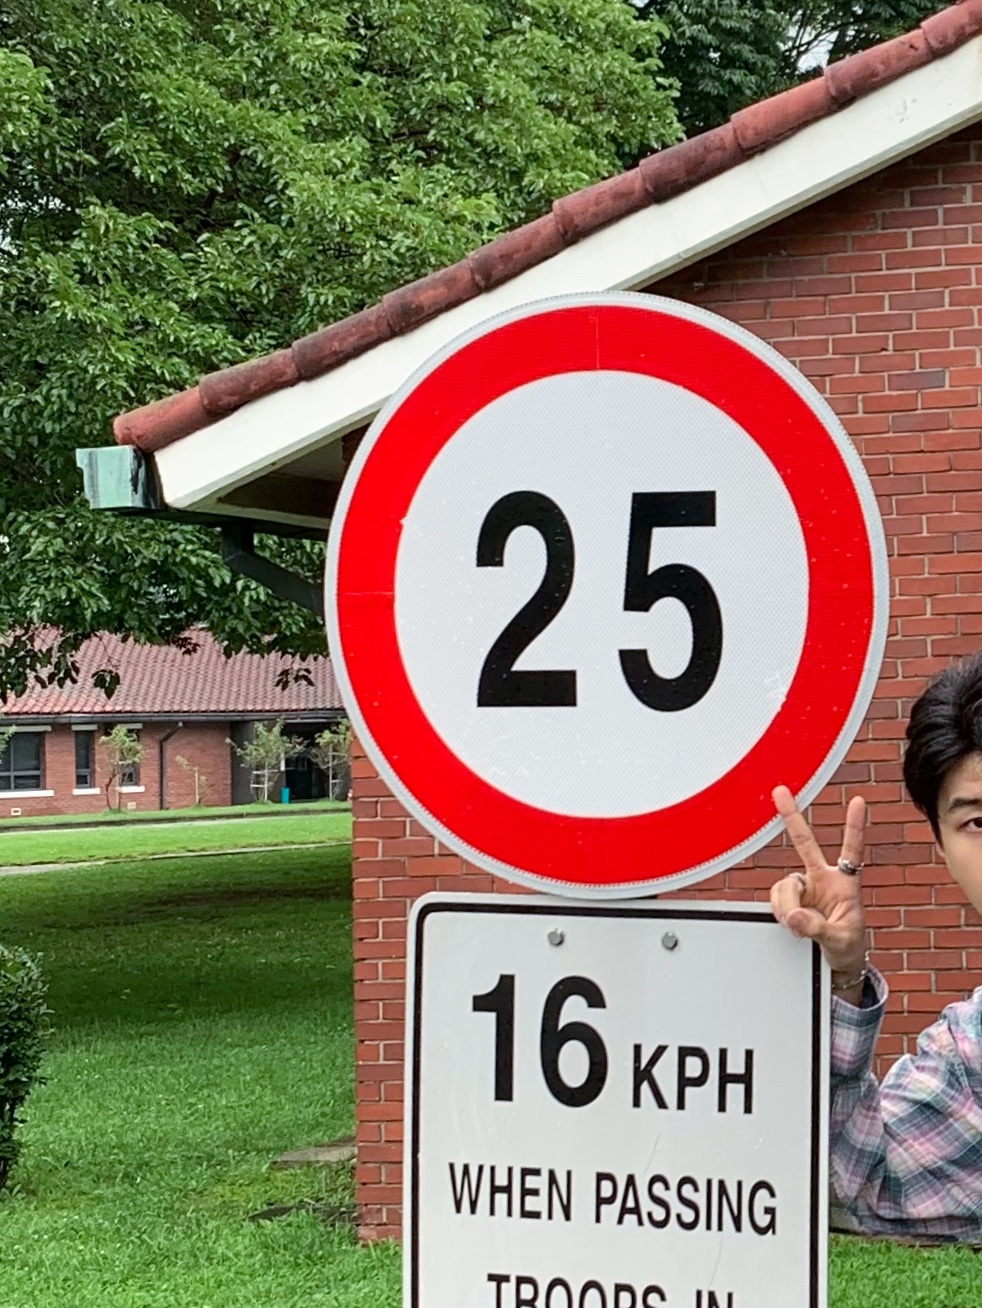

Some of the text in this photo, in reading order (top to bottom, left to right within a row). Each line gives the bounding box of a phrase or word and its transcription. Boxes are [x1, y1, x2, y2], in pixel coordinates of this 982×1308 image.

[476, 489, 724, 713] 25
[472, 974, 754, 1115] 16 KPH
[448, 1162, 777, 1236] WHEN PASSING
